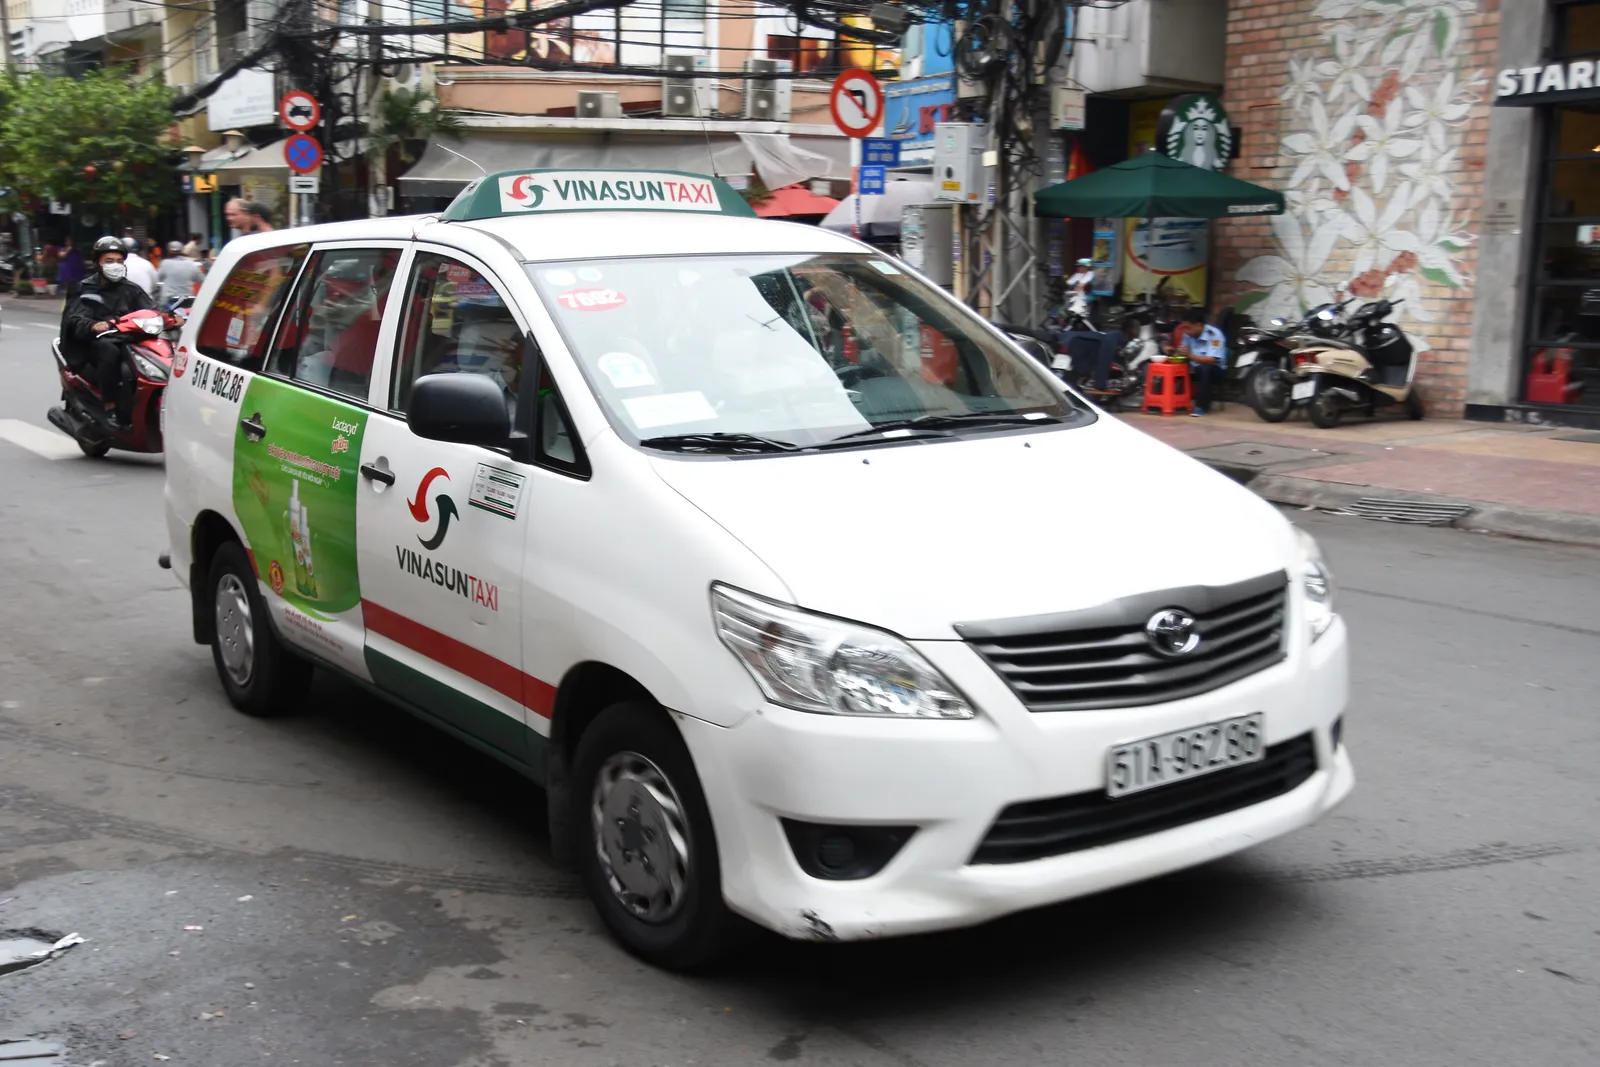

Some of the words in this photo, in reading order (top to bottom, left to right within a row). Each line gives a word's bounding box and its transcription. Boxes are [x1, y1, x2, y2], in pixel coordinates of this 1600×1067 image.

[558, 289, 624, 309] 7692
[192, 360, 211, 390] 51A
[211, 366, 244, 403] 962.86
[332, 417, 358, 436] Lactacyd
